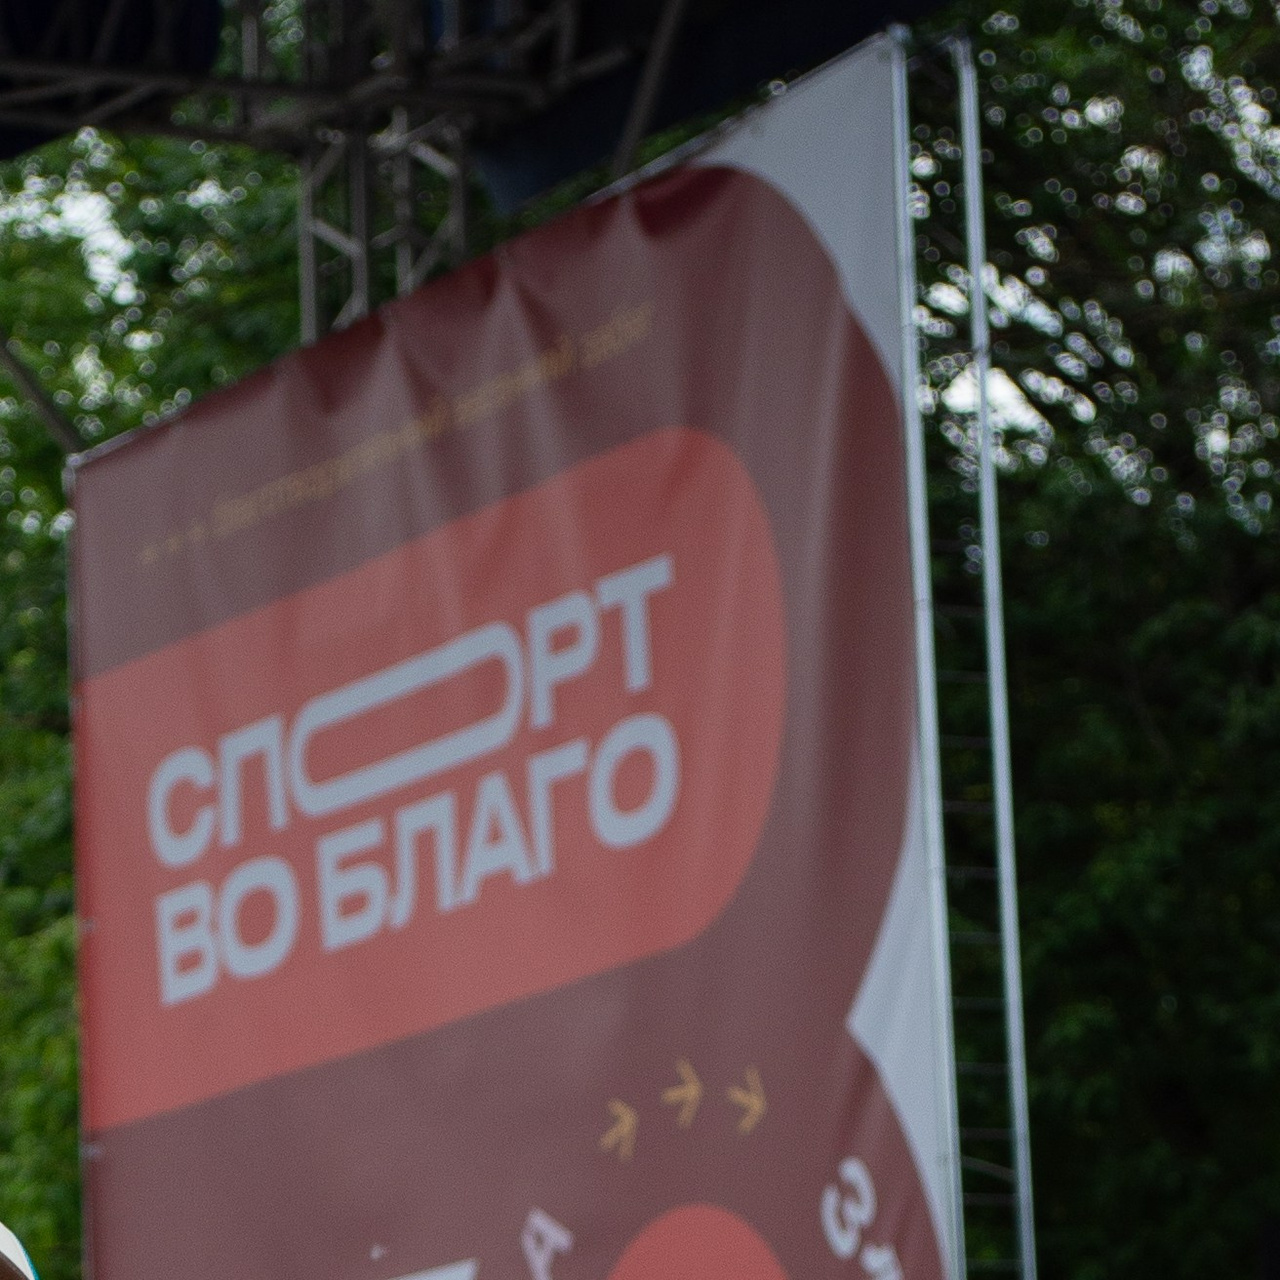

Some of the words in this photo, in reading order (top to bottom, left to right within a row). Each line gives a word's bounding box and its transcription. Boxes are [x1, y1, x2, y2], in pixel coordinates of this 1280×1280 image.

[147, 553, 674, 868] СПОРТ
[154, 856, 300, 1006] ВО
[317, 712, 681, 952] БЛАГО
